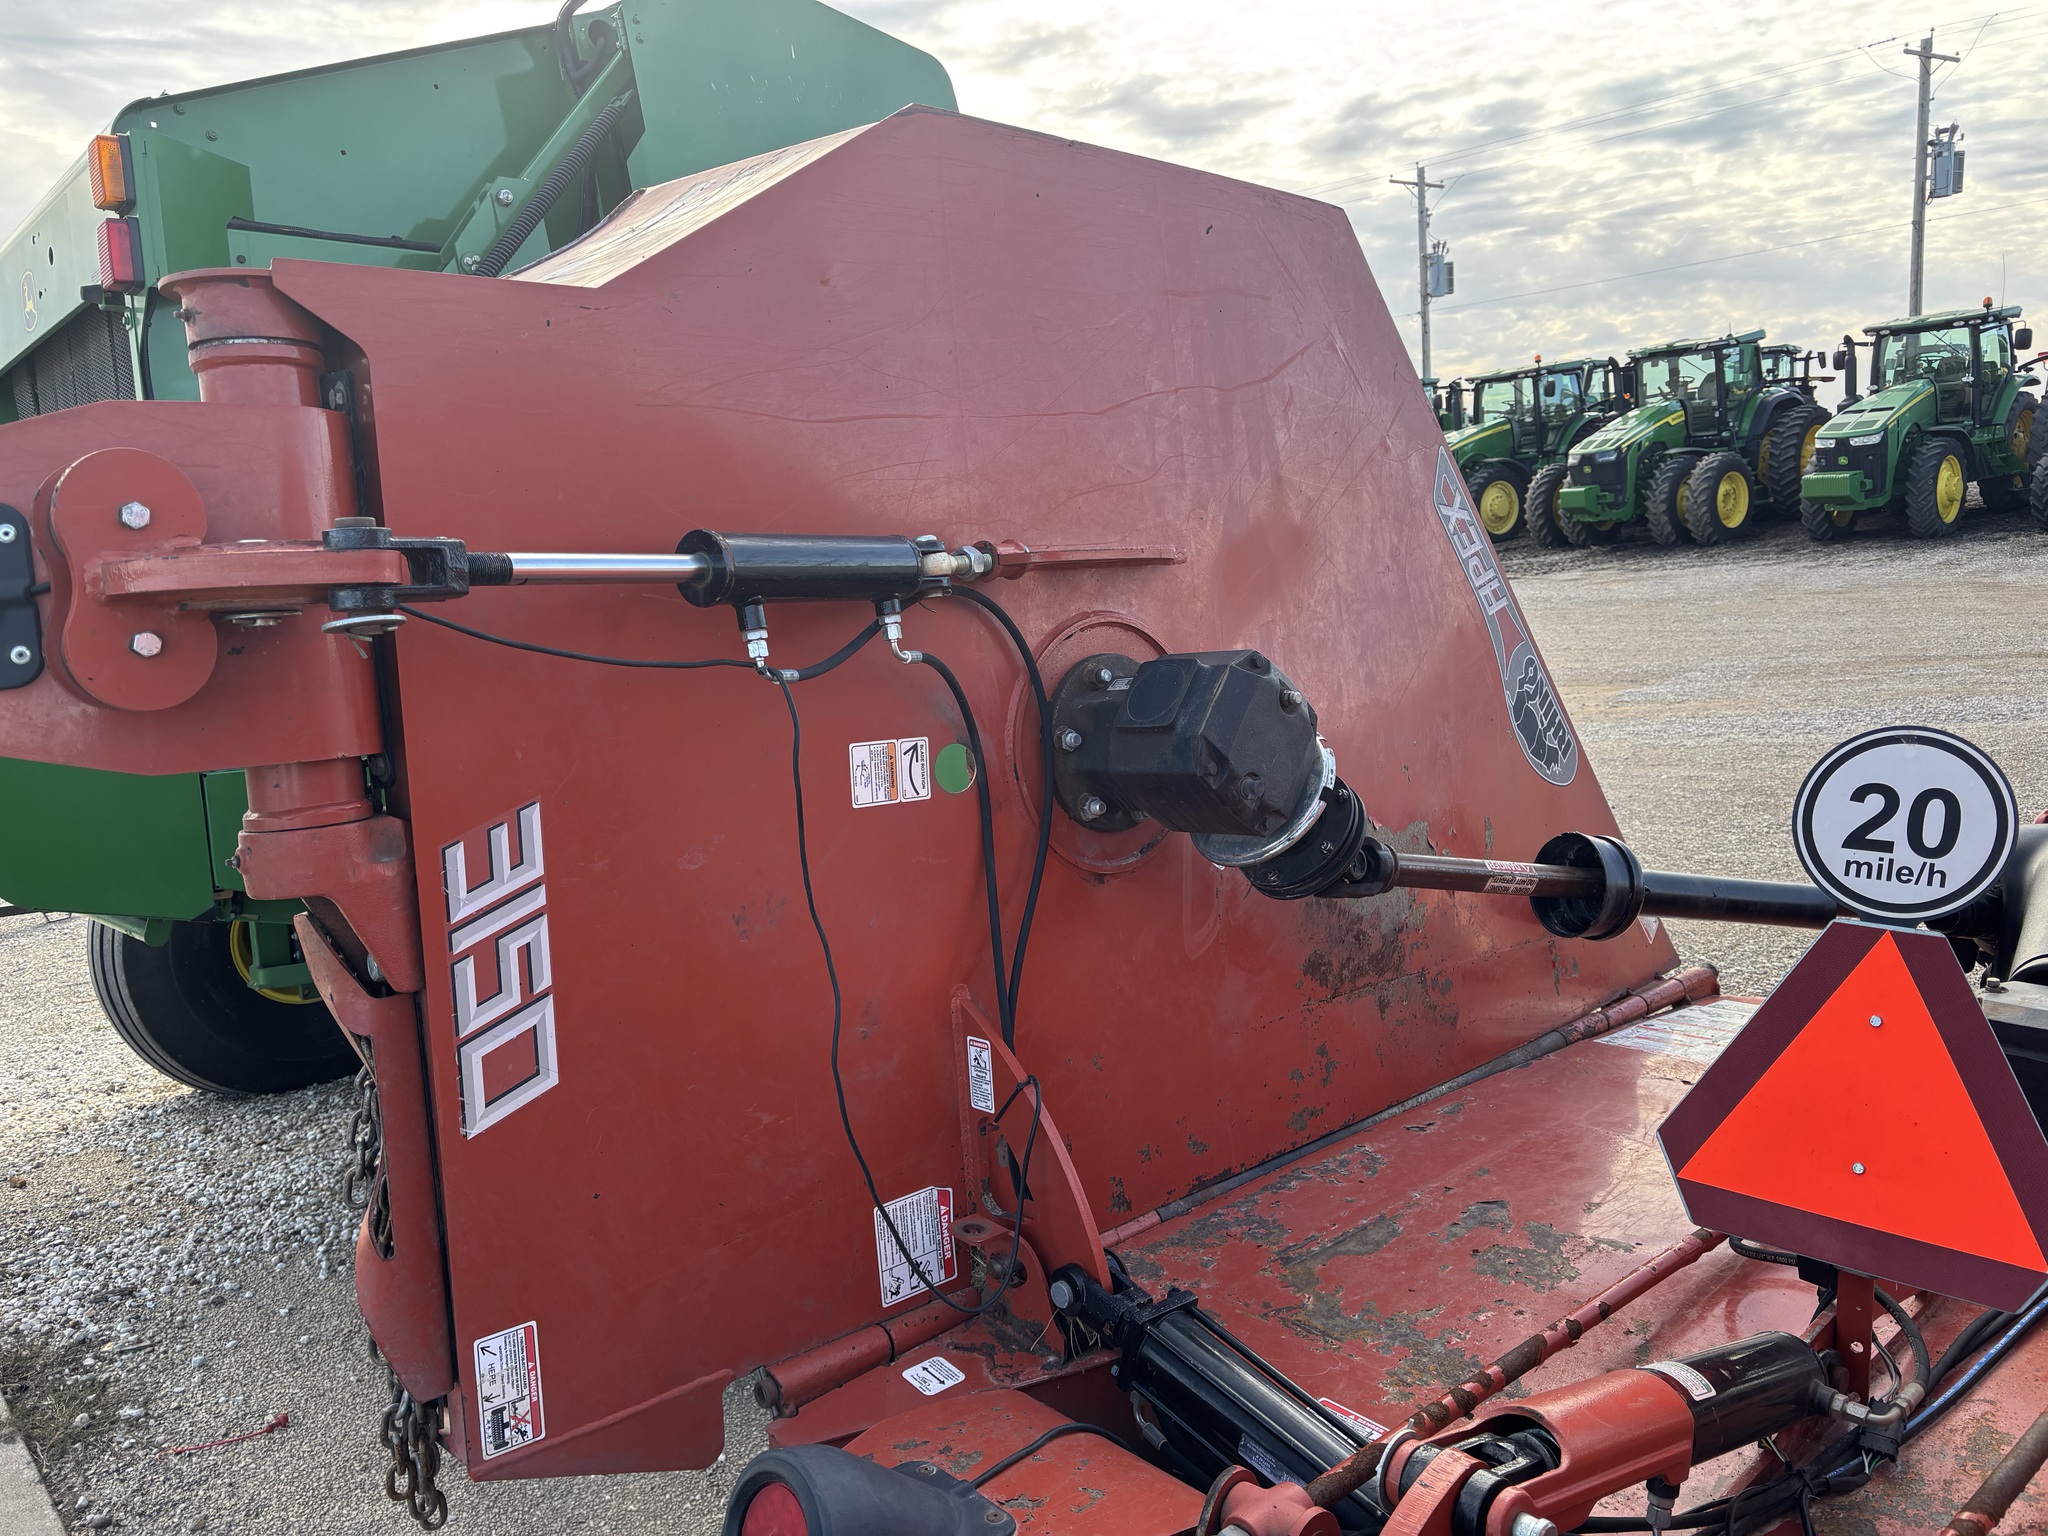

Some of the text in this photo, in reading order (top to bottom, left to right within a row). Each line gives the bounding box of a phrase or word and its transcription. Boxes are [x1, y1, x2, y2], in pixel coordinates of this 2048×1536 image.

[1439, 487, 1508, 616] APEX
[1841, 782, 1962, 860] 20
[1490, 861, 1521, 871] DANGER
[1844, 857, 1947, 889] mile/h
[941, 1215, 952, 1260] DANGER
[529, 1370, 538, 1403] DANGER
[1356, 1418, 1384, 1433] DANGER
